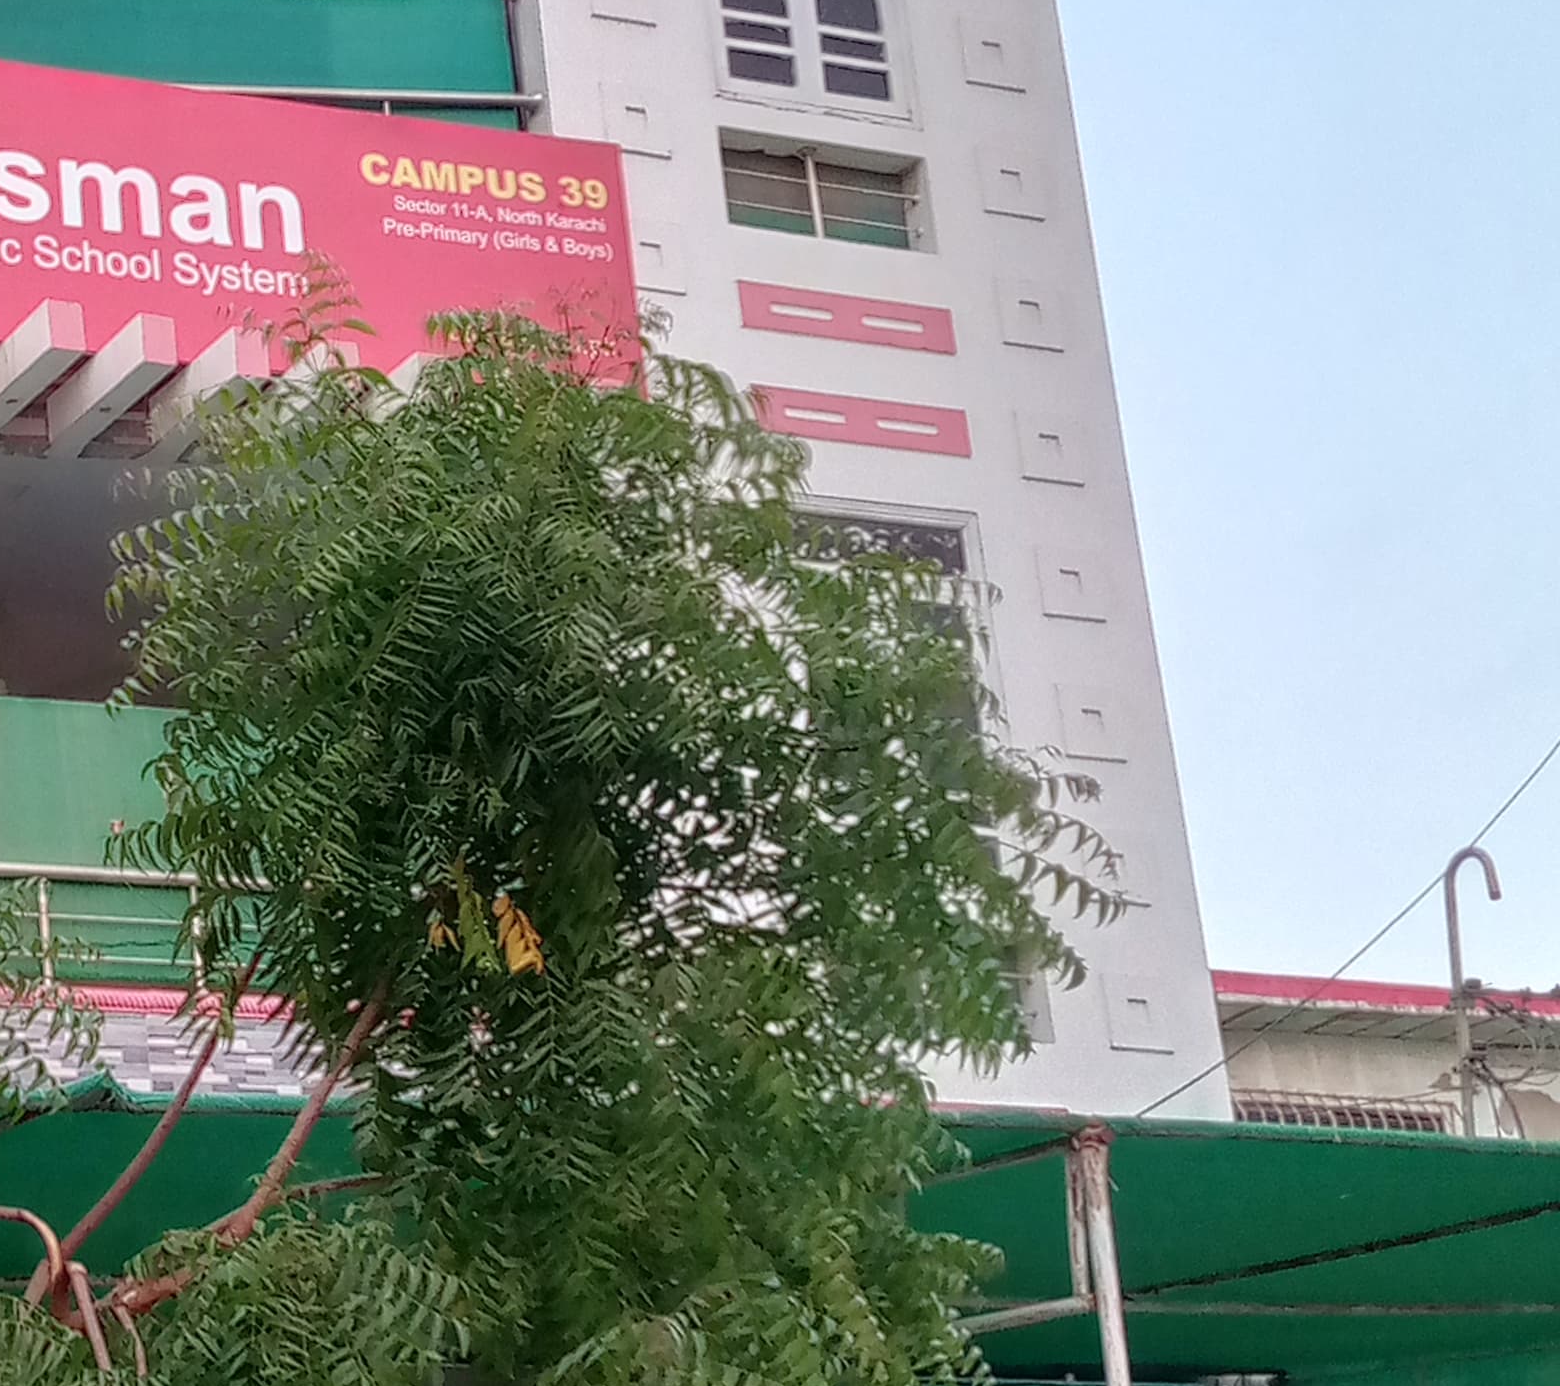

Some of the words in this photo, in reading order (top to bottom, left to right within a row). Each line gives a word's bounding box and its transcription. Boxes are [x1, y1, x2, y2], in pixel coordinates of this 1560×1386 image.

[359, 151, 548, 204] CAMPUS
[557, 175, 609, 210] 39
[382, 216, 489, 250] Pre-Primary
[492, 229, 542, 252] (Girls
[543, 234, 561, 254] &
[561, 237, 615, 263] Boys)
[392, 194, 448, 216] Sector
[450, 201, 494, 224] 11-A,
[496, 206, 544, 227] North
[545, 211, 608, 233] Karachi
[32, 234, 162, 284] School
[172, 251, 310, 298] System
